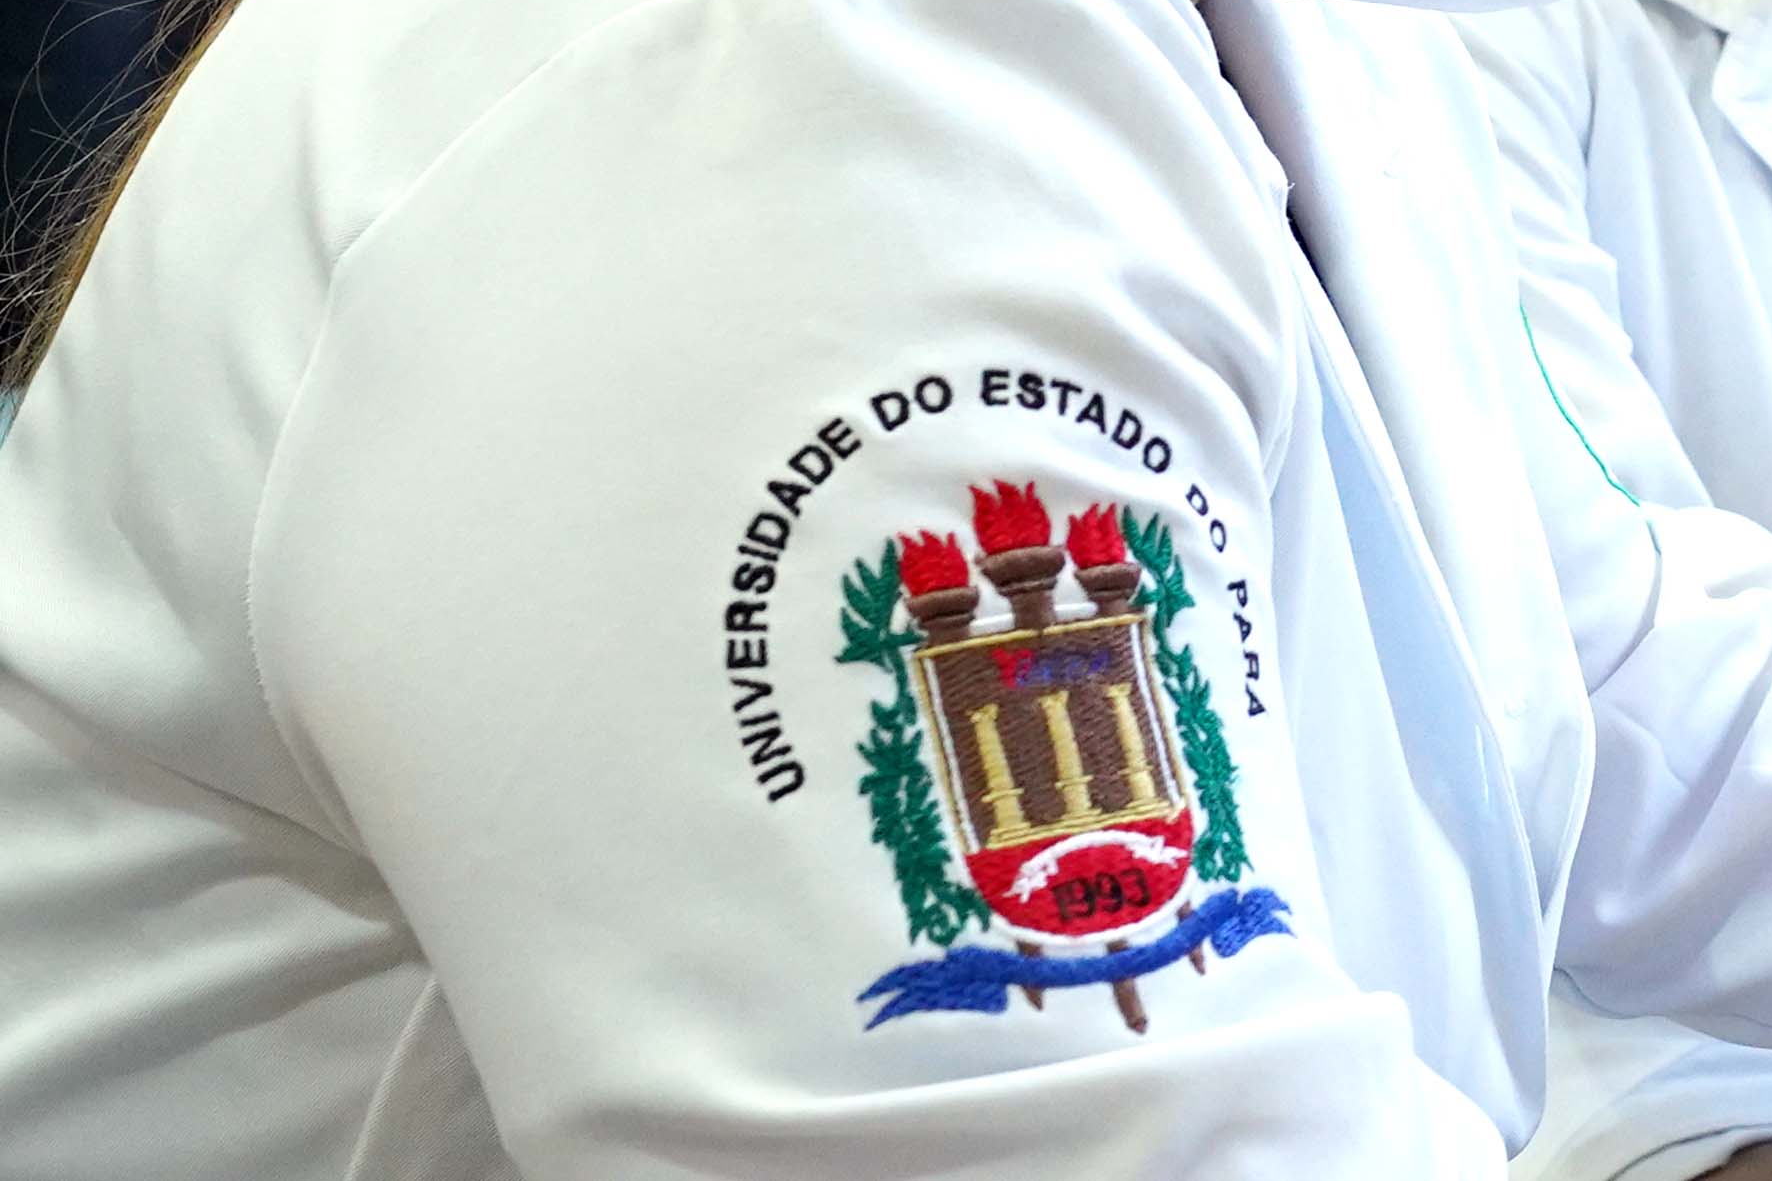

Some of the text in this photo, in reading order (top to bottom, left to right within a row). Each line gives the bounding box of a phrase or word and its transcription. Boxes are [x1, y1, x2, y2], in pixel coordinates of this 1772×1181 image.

[722, 416, 864, 803] UNIVERSIDADE
[870, 374, 954, 432] DO
[979, 368, 1172, 475] ESTADO
[1185, 483, 1227, 554] DO
[1051, 866, 1151, 924] 1993
